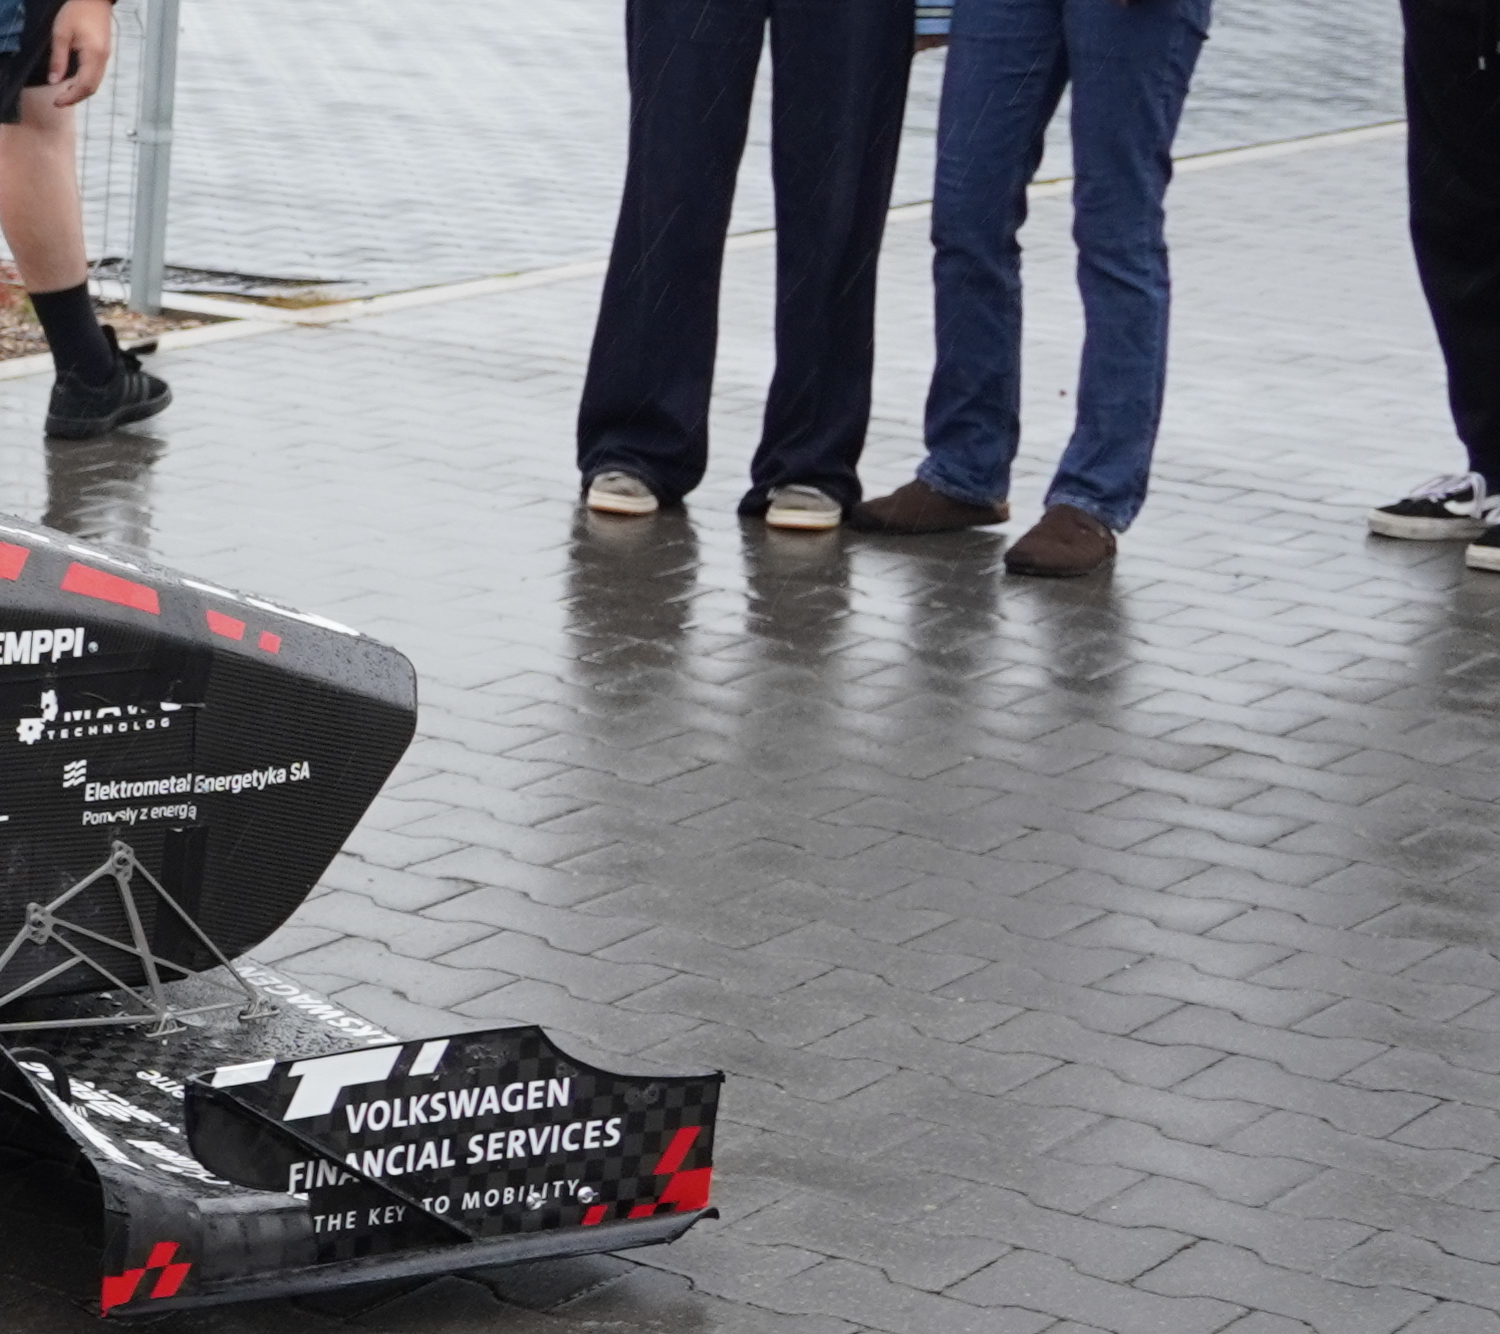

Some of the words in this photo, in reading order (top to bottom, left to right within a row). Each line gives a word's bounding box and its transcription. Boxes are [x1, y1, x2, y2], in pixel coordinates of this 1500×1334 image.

[85, 773, 192, 801] Elektrometal
[194, 767, 286, 793] Energetyka
[290, 761, 310, 781] SA
[237, 965, 398, 1045] LKSWAGEN
[346, 1077, 571, 1134] VOLKSWAGEN
[466, 1118, 621, 1165] SERVICES
[314, 1211, 356, 1233] THE
[368, 1206, 406, 1225] KEY
[423, 1196, 450, 1215] TO
